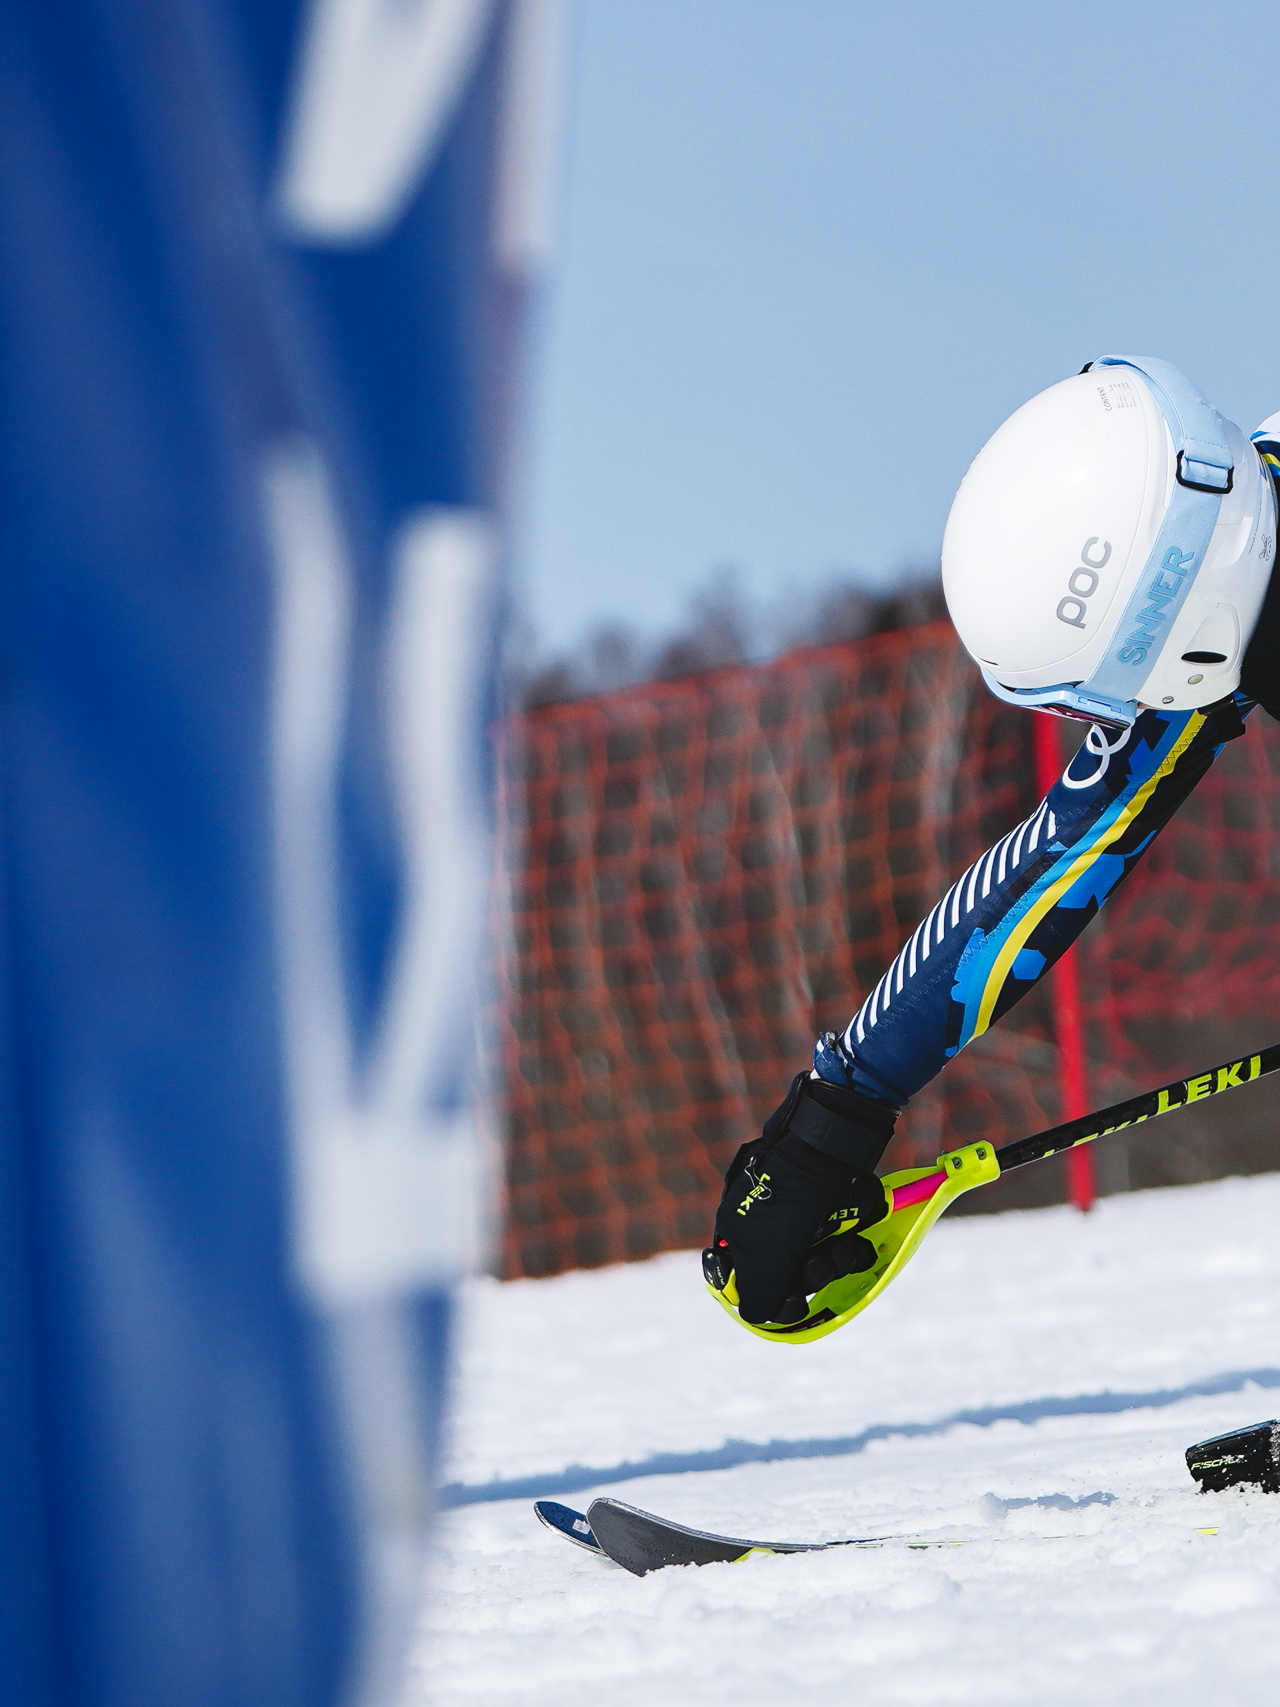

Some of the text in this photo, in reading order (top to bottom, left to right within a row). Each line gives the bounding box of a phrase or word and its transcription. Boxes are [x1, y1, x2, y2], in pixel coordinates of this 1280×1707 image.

[1119, 545, 1195, 666] SINNER
[1156, 1055, 1262, 1116] LEKI
[736, 1172, 771, 1216] LEKI
[828, 1206, 859, 1221] LEK
